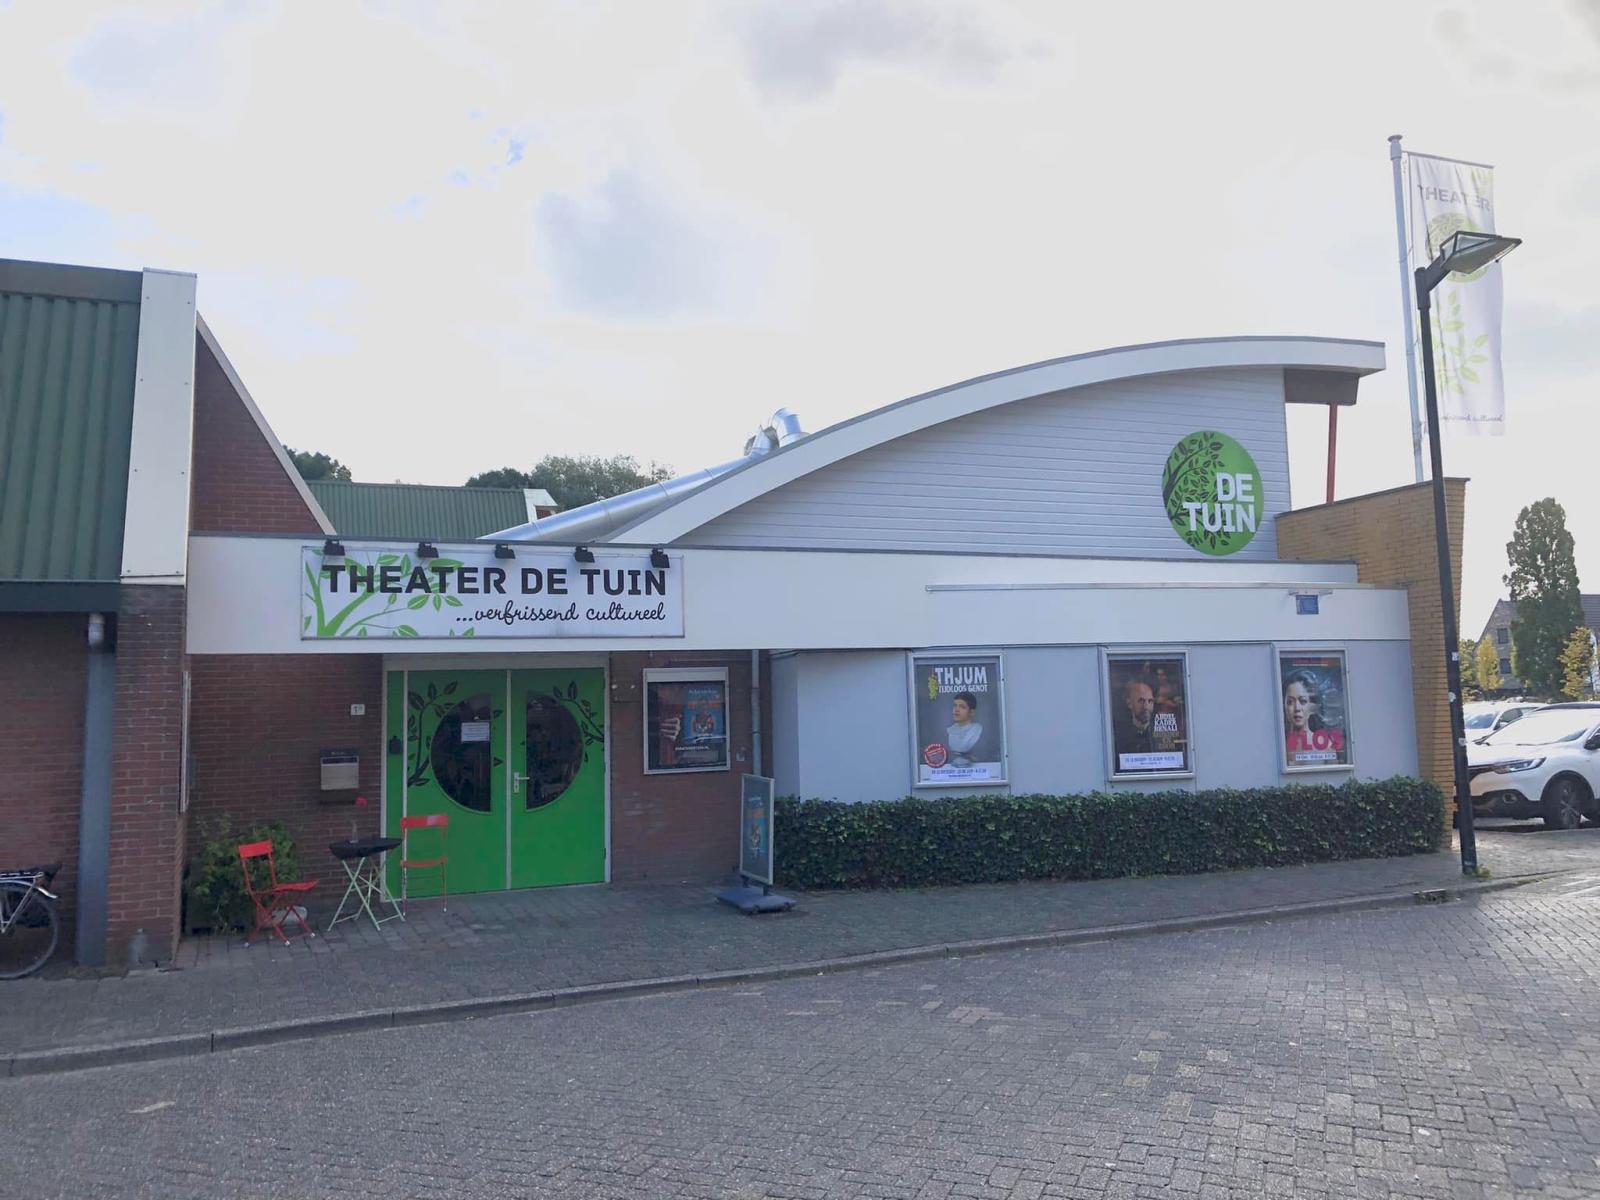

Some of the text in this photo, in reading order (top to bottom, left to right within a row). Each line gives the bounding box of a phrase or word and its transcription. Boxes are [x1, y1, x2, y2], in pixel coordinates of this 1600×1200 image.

[1216, 472, 1254, 502] DE
[1182, 502, 1256, 532] TUIN
[322, 564, 666, 596] THEATER DE TUIN
[586, 602, 666, 622] cultureel
[935, 666, 988, 685] THJUM
